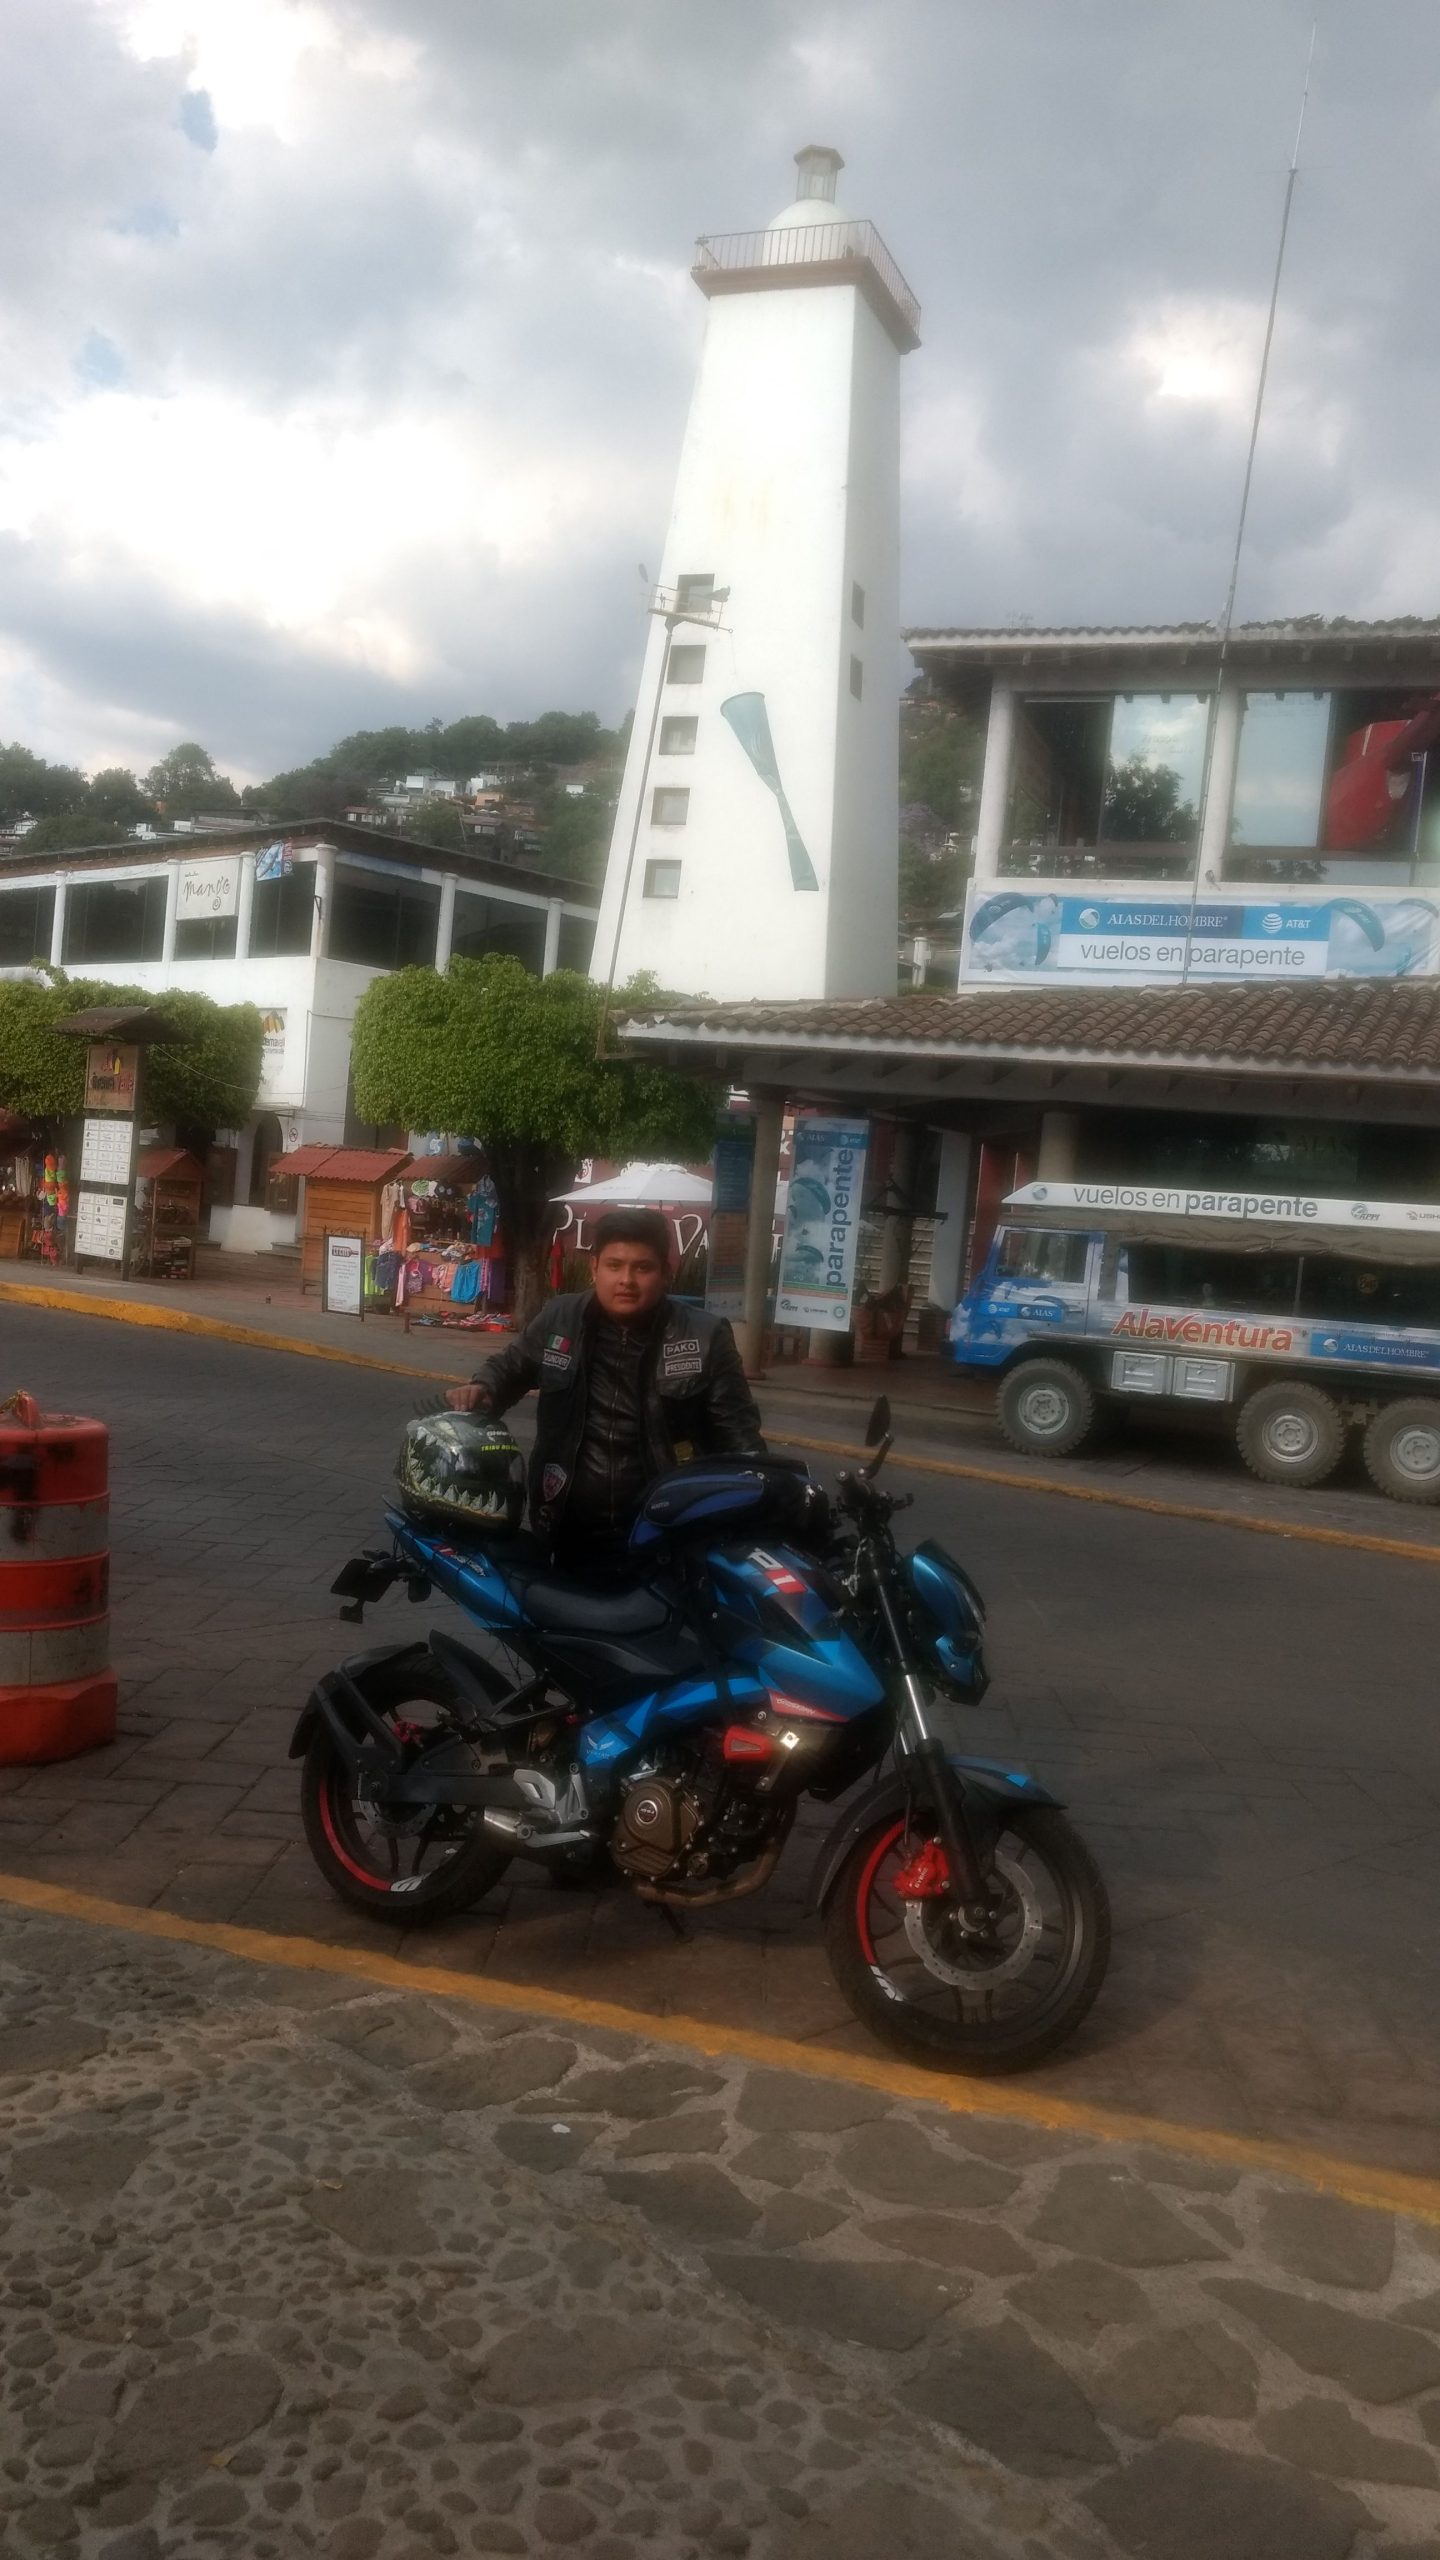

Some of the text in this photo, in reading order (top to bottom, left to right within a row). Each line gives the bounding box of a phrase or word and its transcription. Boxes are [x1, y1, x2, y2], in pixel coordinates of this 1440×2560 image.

[1286, 919, 1311, 929] AT&T
[1081, 941, 1306, 969] vuelos en parapente
[1073, 1186, 1319, 1219] vuelos en parapente
[826, 1146, 854, 1288] parapente
[666, 1342, 696, 1356] PAKO
